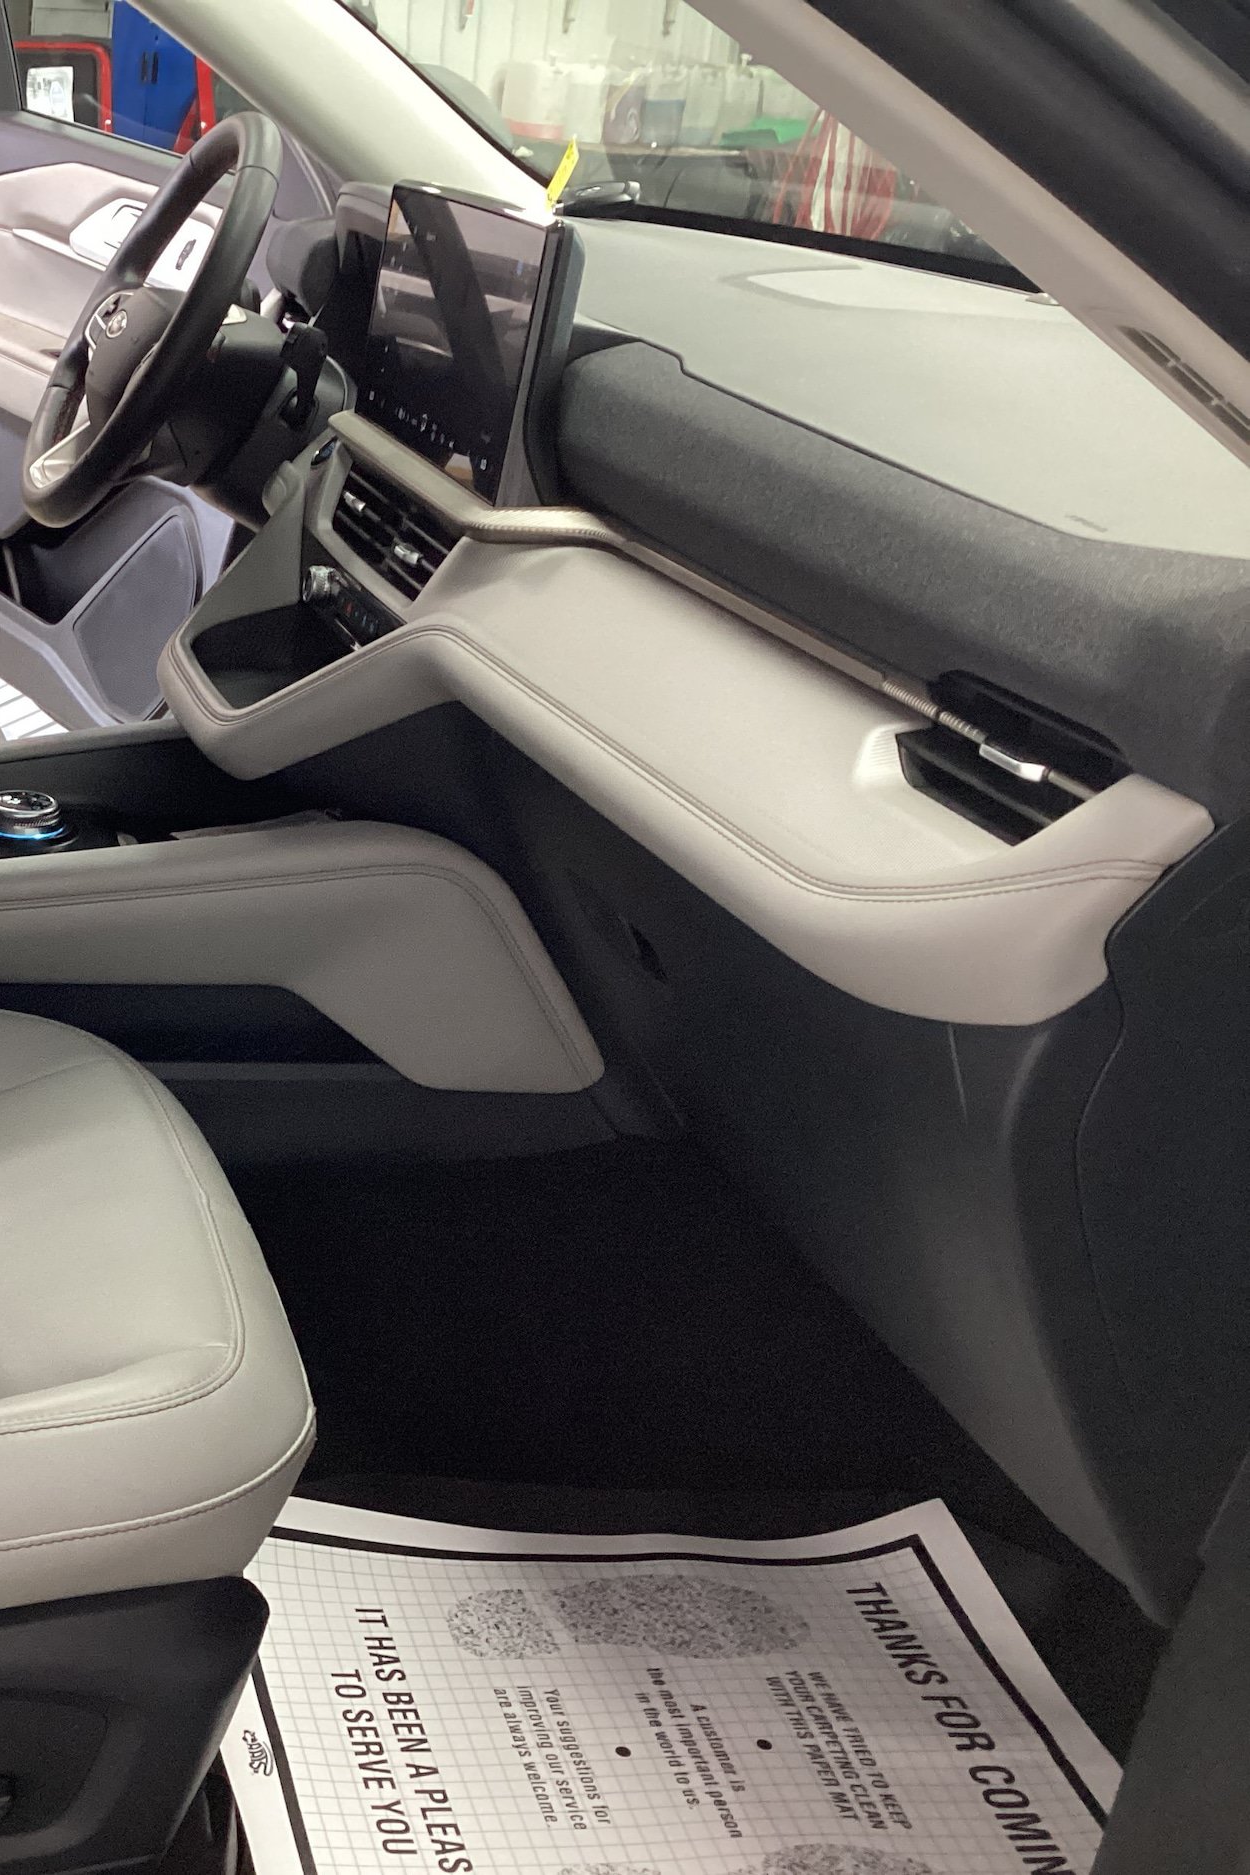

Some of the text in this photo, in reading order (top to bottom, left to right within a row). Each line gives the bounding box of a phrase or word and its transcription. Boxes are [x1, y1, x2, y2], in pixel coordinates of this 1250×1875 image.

[331, 1669, 418, 1855] TO SERVE YOU
[355, 1608, 474, 1874] IT HAS BEEN A PLEAS
[493, 1688, 512, 1708] are
[503, 1712, 532, 1758] always
[517, 1685, 587, 1830] improving our service
[543, 1688, 611, 1824] Your suggestions for
[634, 1692, 651, 1704] in
[643, 1707, 662, 1727] the
[654, 1731, 686, 1768] world
[674, 1771, 690, 1785] to
[646, 1667, 743, 1838] the most important person
[690, 1704, 746, 1792] A customer is
[766, 1676, 860, 1821] WITH THIS PAPER MAT
[785, 1671, 888, 1829] YOUR CARPETING CLEAN
[807, 1672, 913, 1830] WE HAVE TRIED TO KEEP
[846, 1582, 1077, 1875] THANKS FOR COMIN
